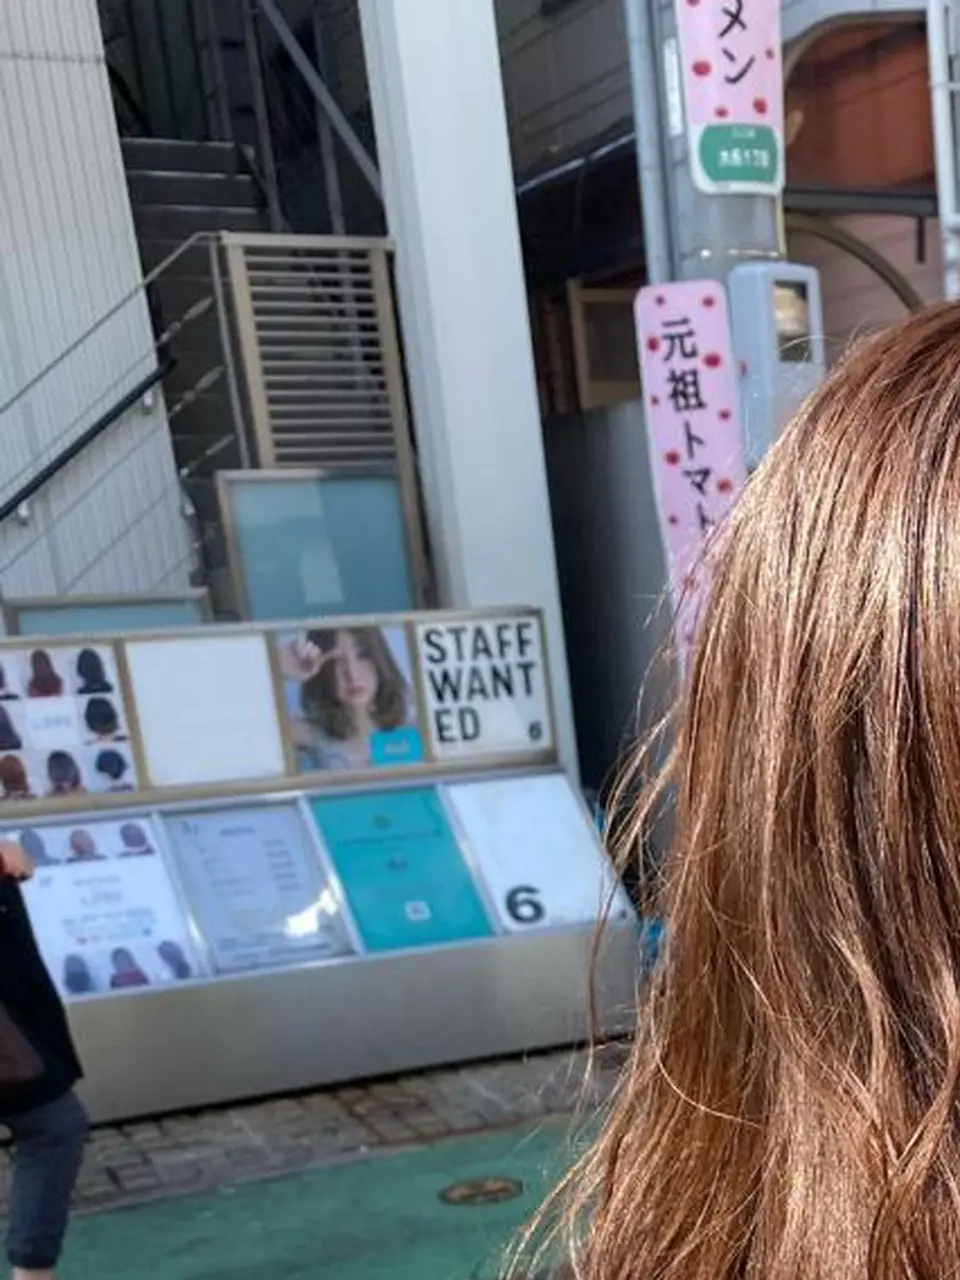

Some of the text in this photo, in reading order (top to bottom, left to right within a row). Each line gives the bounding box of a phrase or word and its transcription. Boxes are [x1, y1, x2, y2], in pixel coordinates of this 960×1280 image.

[661, 317, 715, 531] 元祖トマト
[424, 622, 532, 664] STAFF
[428, 661, 535, 704] WANT
[434, 706, 481, 743] ED
[505, 884, 545, 924] 6
